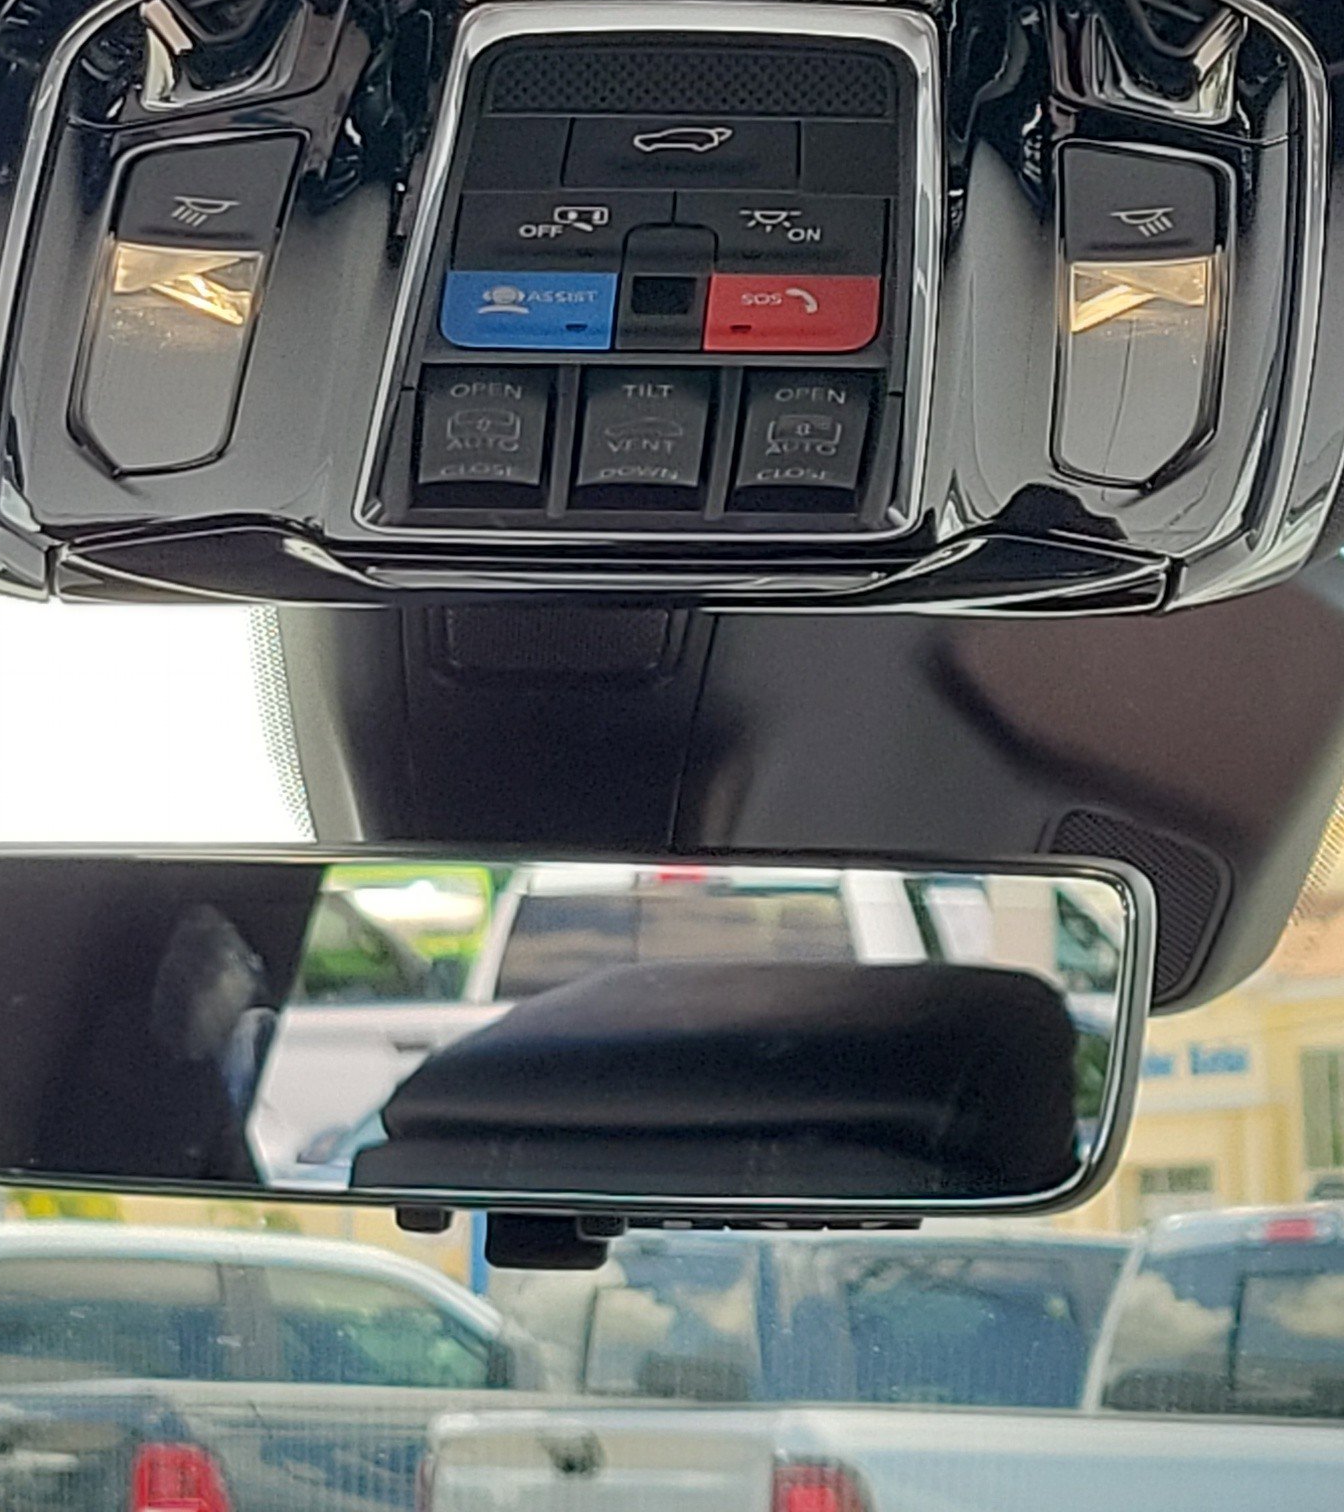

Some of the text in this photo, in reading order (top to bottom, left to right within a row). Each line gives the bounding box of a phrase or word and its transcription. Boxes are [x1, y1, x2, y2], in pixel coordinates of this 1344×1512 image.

[518, 224, 563, 239] OFF
[787, 226, 822, 242] ON
[526, 289, 598, 303] ASSIST
[740, 291, 783, 306] SOS
[449, 382, 523, 400] OPEN
[622, 384, 674, 399] TILT
[774, 387, 847, 404] OPEN
[445, 438, 520, 452] AUTO
[607, 439, 674, 453] VENT
[765, 439, 838, 456] AUTO
[599, 465, 679, 481] DOWN
